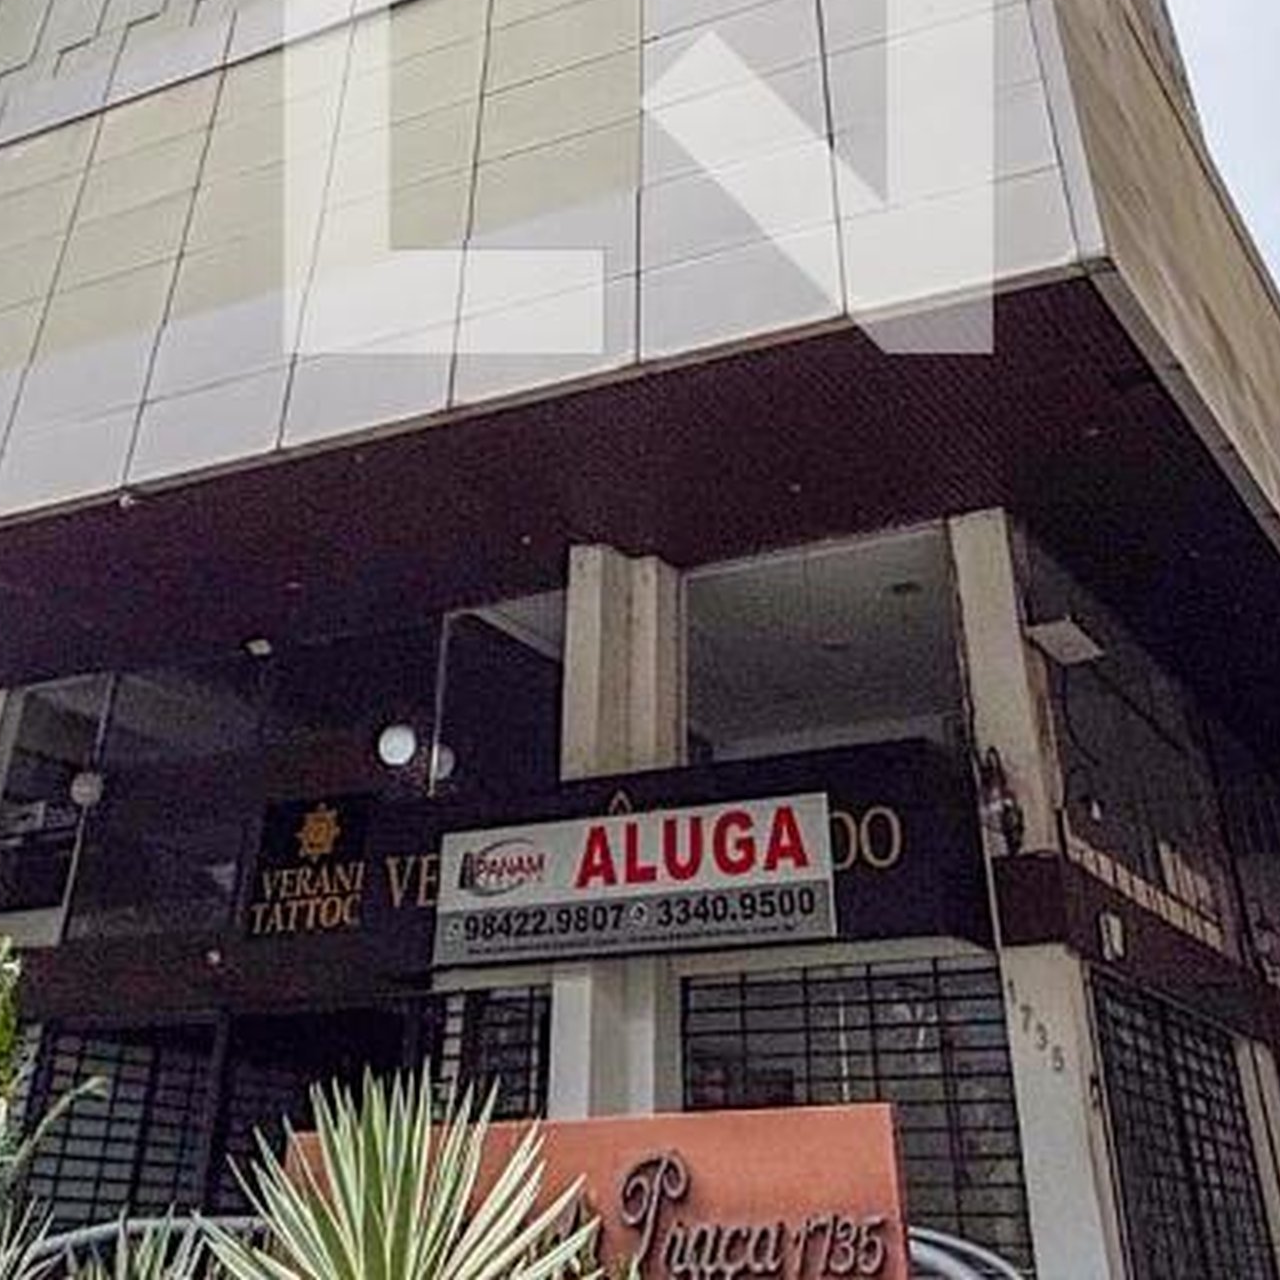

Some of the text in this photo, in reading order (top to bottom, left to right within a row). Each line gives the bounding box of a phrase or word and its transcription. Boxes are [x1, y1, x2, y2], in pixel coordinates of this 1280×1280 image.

[575, 805, 810, 889] ALUGA
[262, 861, 365, 900] VERANI
[384, 853, 440, 909] VE
[464, 905, 626, 941] 98422.9807
[656, 887, 816, 928] 3340.9500
[794, 1216, 884, 1276] 1735
